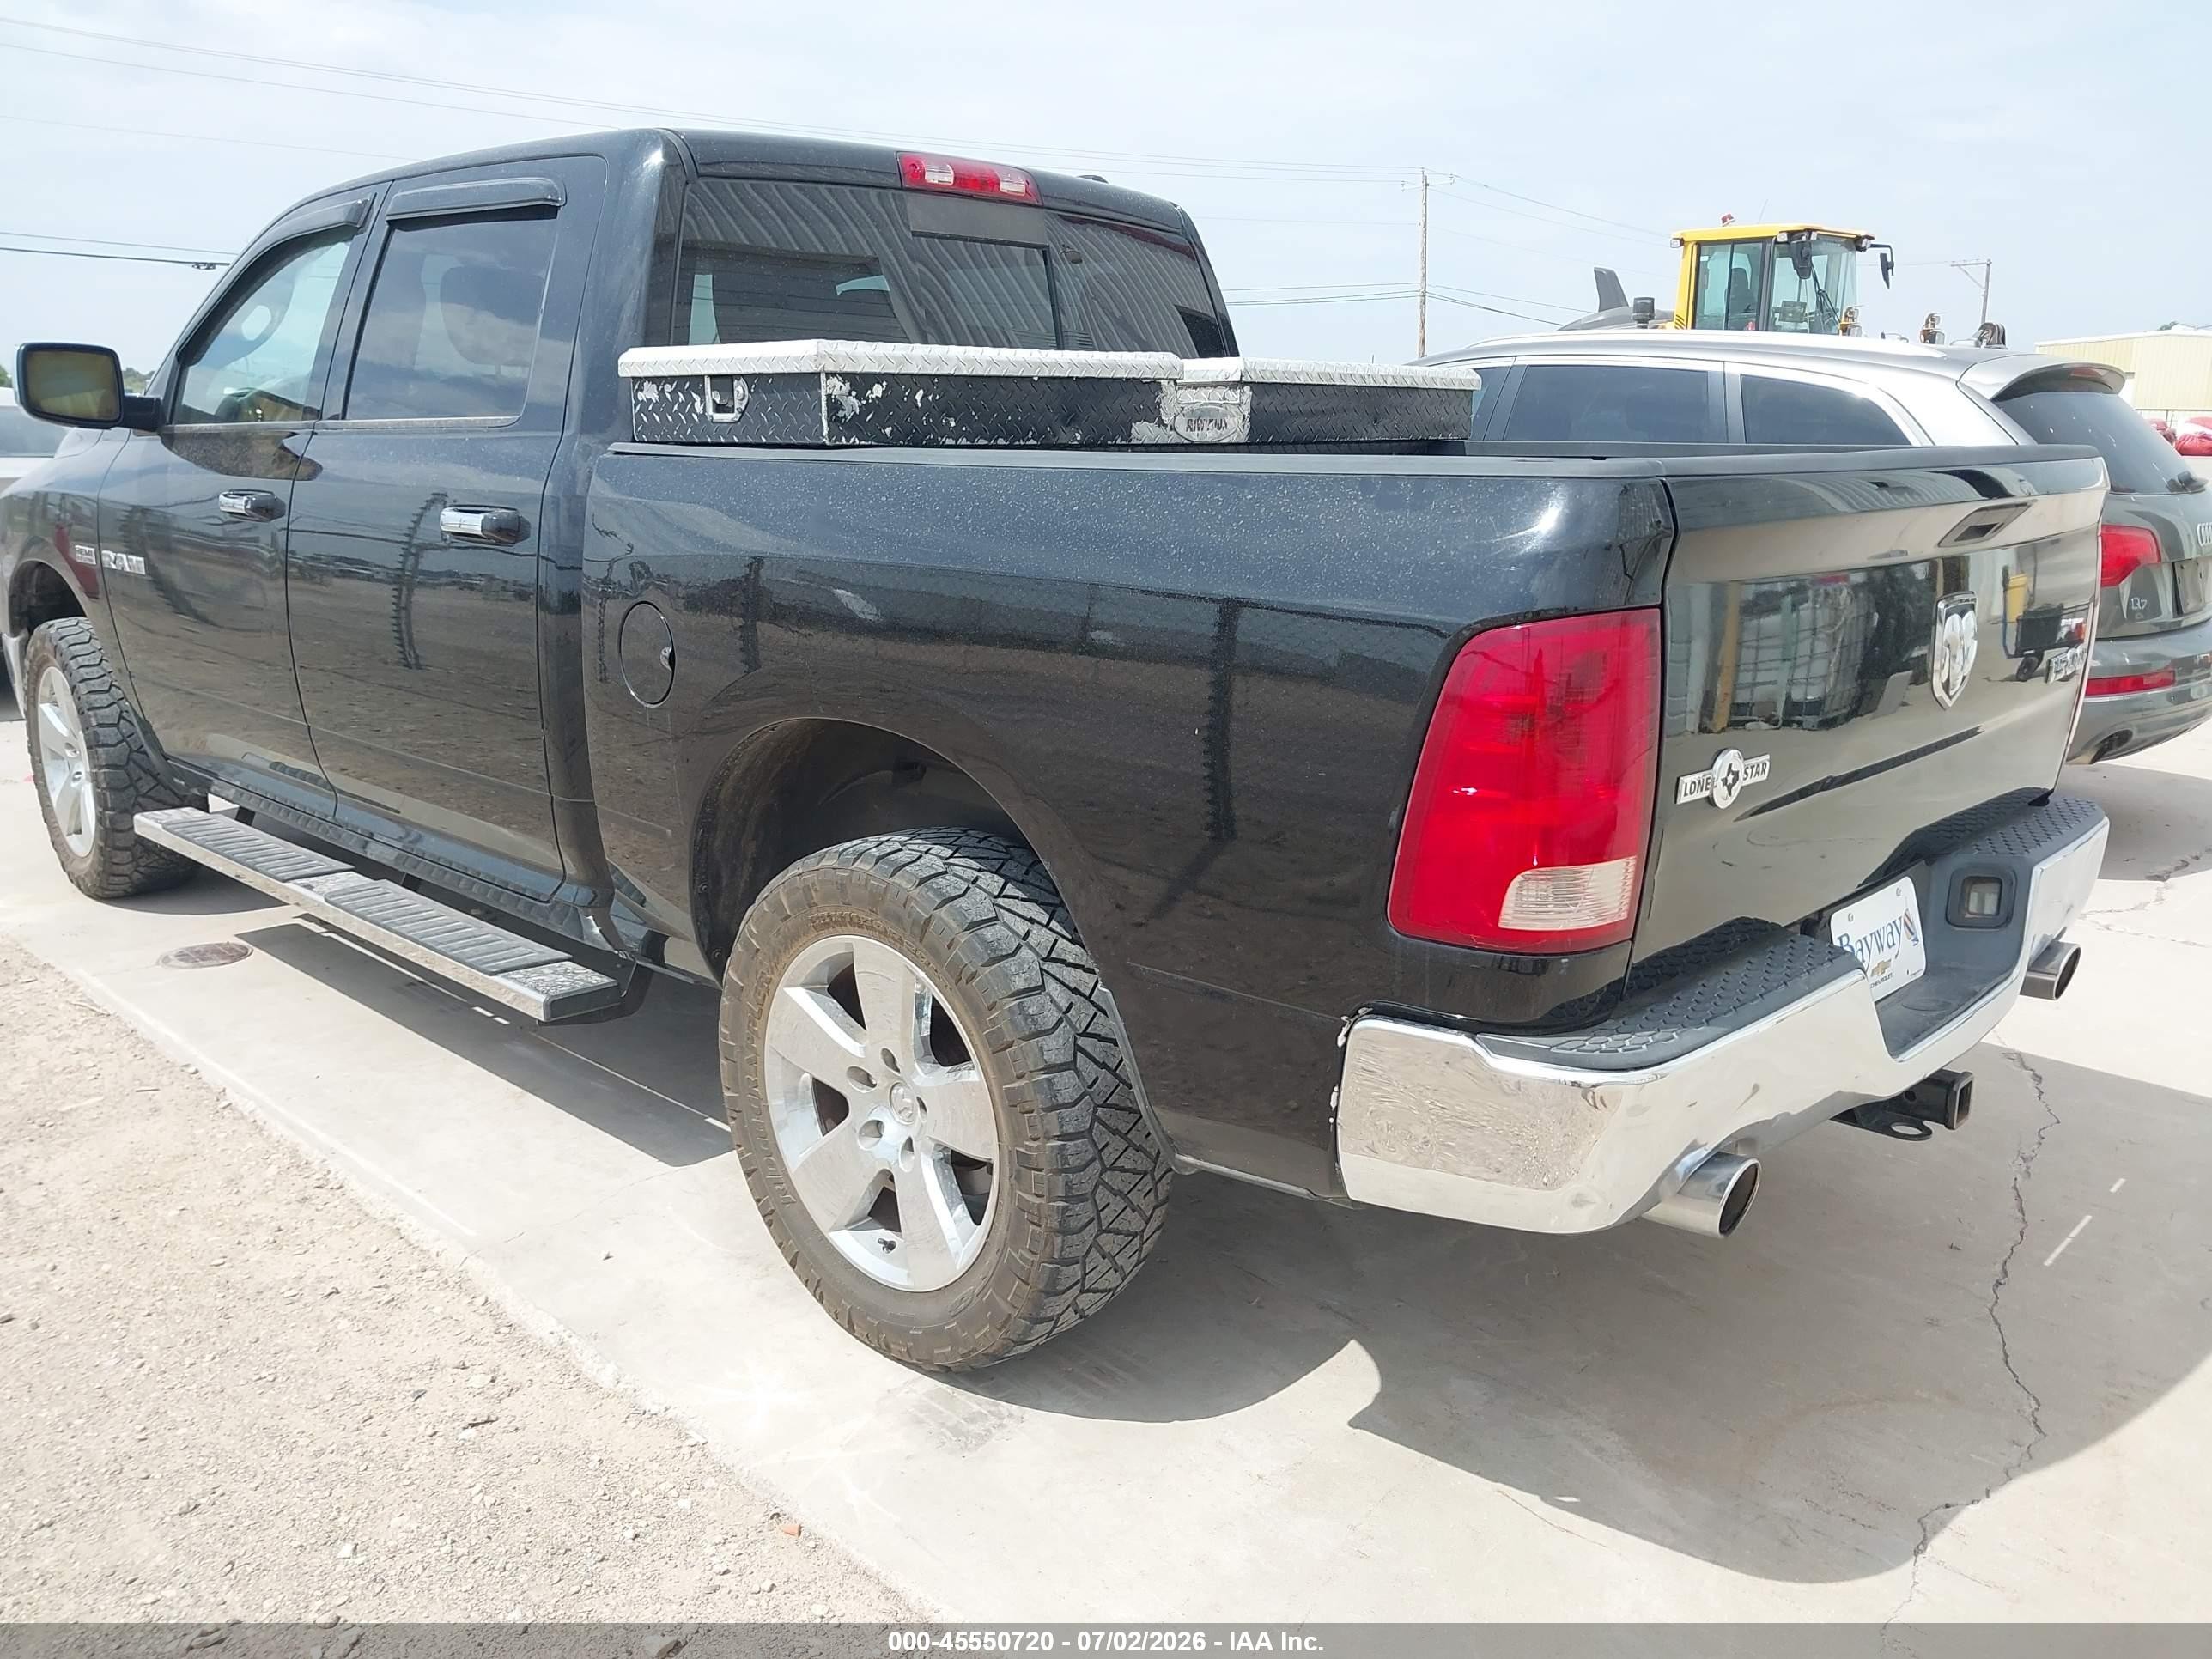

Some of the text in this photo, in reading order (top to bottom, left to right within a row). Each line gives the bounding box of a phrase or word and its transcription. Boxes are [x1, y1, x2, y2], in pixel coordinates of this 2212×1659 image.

[1683, 761, 1768, 798] LONE STAR
[1837, 915, 1904, 973] Bayway
